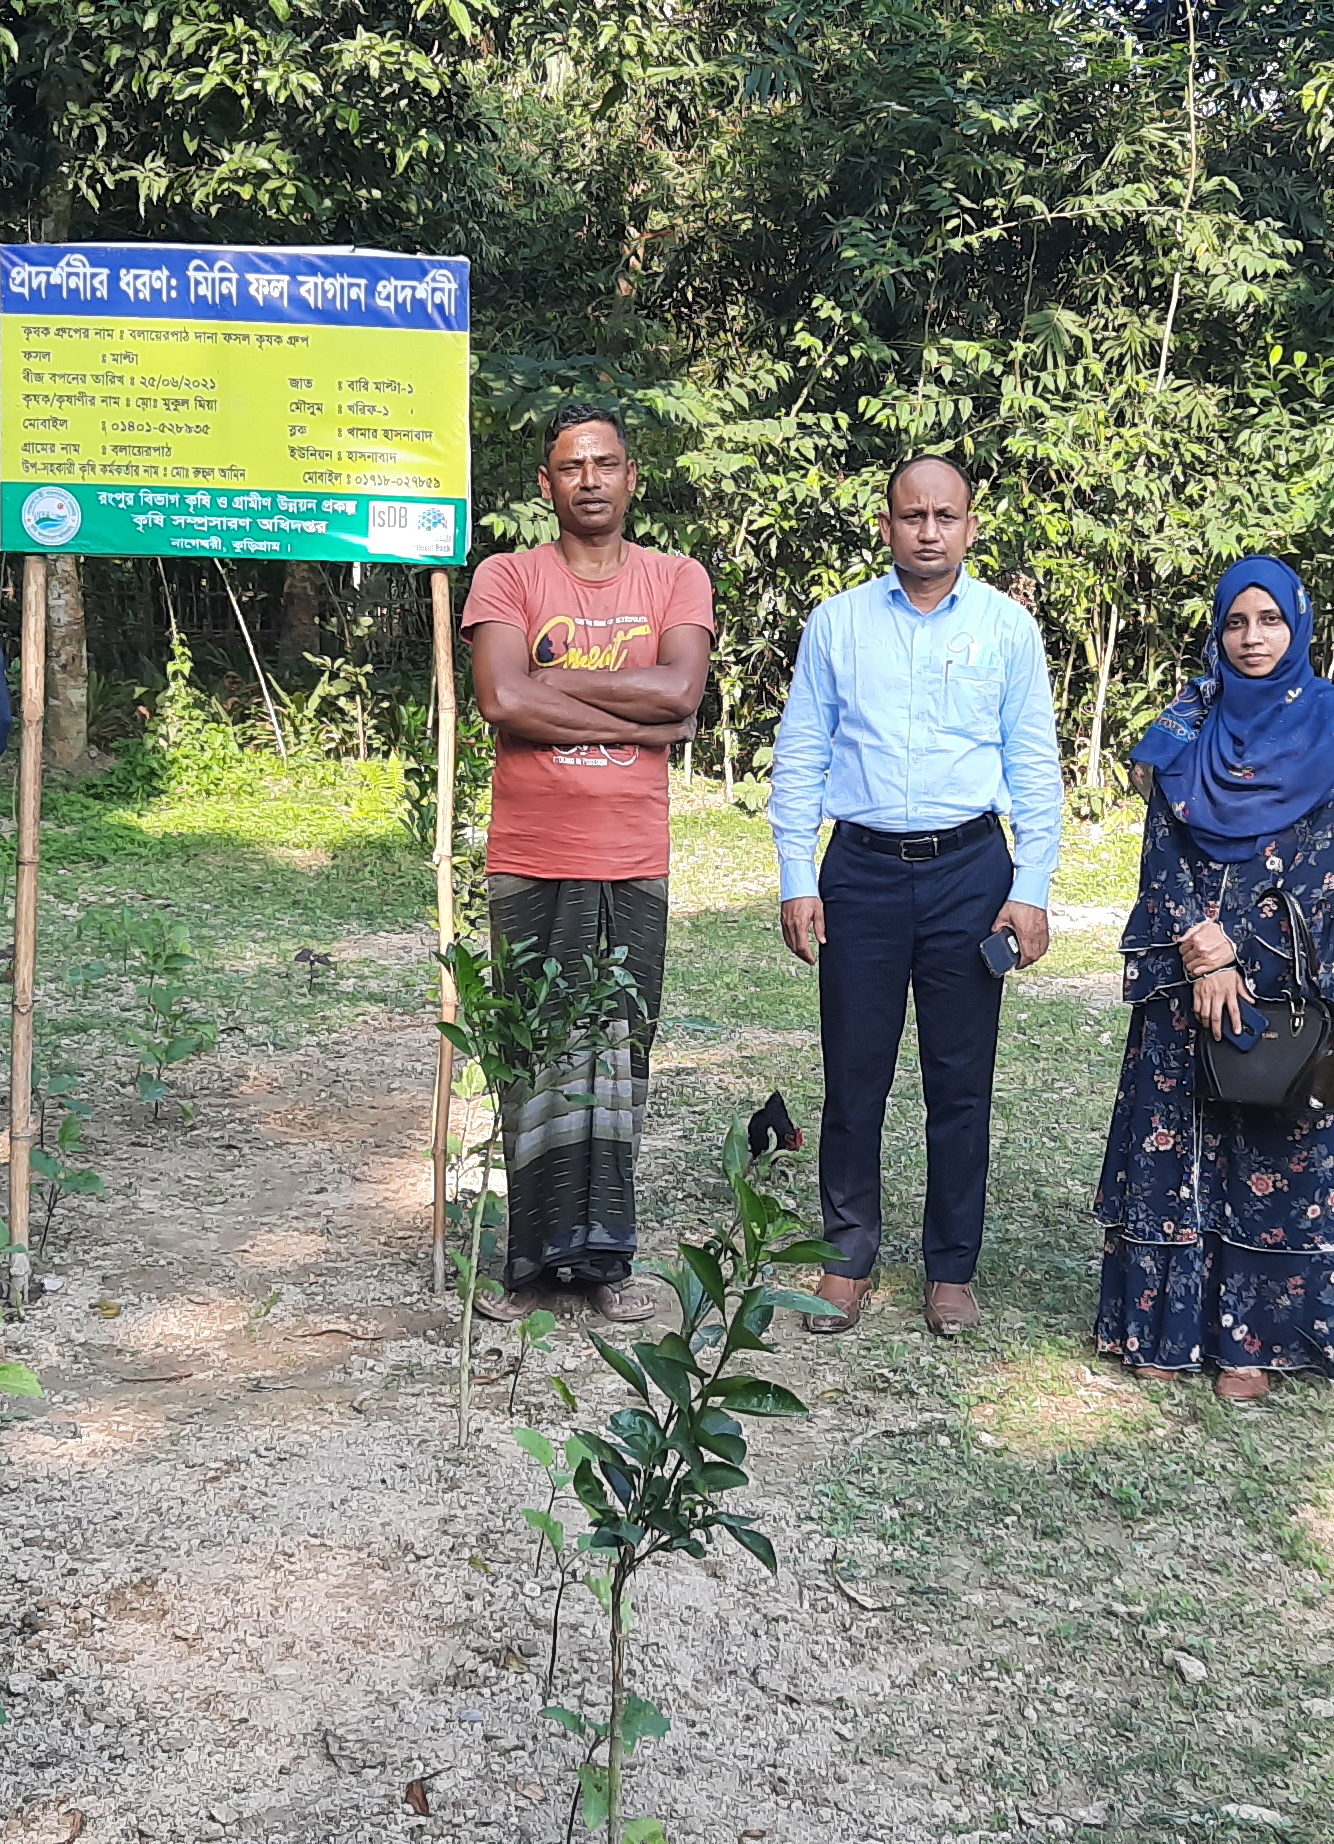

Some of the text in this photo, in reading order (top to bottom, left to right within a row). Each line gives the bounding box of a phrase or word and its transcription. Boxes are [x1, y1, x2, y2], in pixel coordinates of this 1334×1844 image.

[9, 253, 111, 301] প্রদর্শনীর
[186, 258, 240, 308] মিনি
[244, 272, 290, 308] ফল
[296, 272, 368, 312] বাগান
[375, 269, 459, 317] প্রদর্শনী
[21, 326, 51, 343] কৃষক
[93, 327, 115, 340] নাম
[194, 331, 218, 345] দানা
[221, 332, 251, 346] ফসল
[254, 333, 283, 351] কৃষক
[22, 368, 45, 384] বীজ
[90, 371, 126, 386] তারিখ
[288, 377, 314, 390] জাত
[346, 377, 369, 393] বারি
[100, 396, 120, 408] নাম
[22, 415, 69, 431] মোবাইল
[21, 441, 56, 454] গ্রামের
[59, 443, 80, 455] নাম
[142, 464, 159, 478] নাম
[303, 469, 343, 487] মোবাইল
[97, 490, 135, 509] রংপুর
[139, 489, 180, 508] বিভাগ
[183, 490, 212, 514] কৃষি
[217, 494, 227, 508] ও
[231, 492, 272, 512] গ্রামীণ
[130, 510, 329, 535] কৃষি সম্প্রসারণ অধিদপ্তর
[372, 505, 408, 529] IsDB
